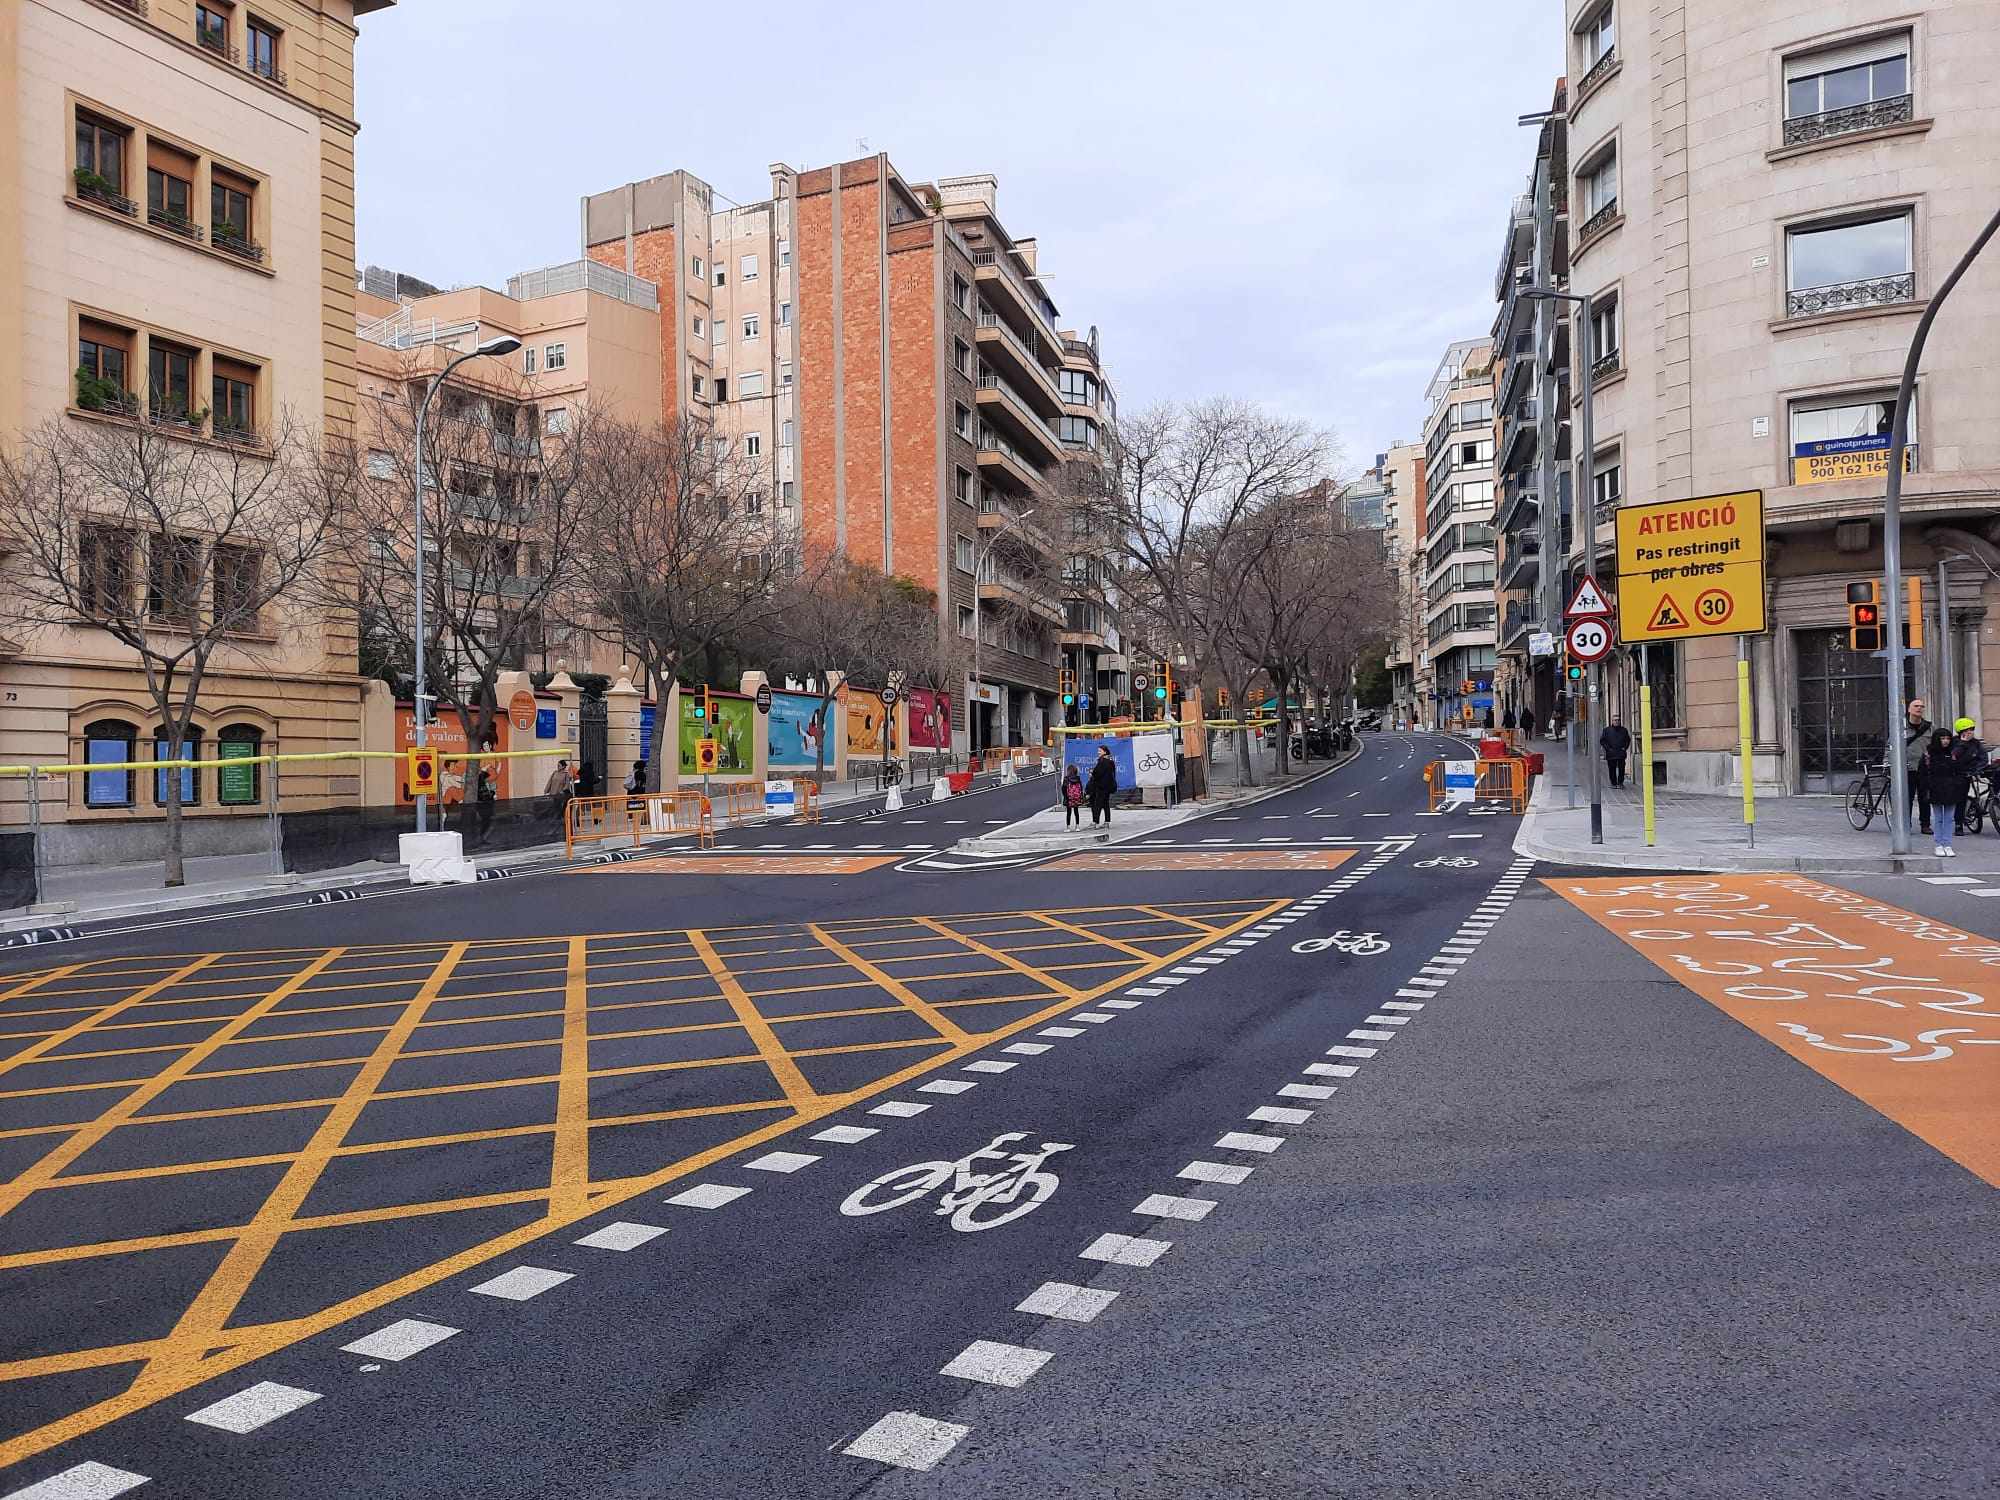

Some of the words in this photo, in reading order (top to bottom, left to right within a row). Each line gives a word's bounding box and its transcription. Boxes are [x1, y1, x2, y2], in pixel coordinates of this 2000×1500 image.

[1810, 450, 1891, 468] DISPONIBLE
[1811, 467, 1835, 478] 900
[1839, 465, 1861, 475] 162
[1867, 462, 1889, 472] 164
[1638, 501, 1736, 536] ATENCIÓ
[1636, 548, 1663, 561] Pas
[1668, 537, 1741, 558] restringit
[1651, 567, 1675, 583] per
[1680, 562, 1725, 578] obres
[1703, 598, 1726, 616] 30
[1576, 632, 1602, 648] 30
[6, 692, 18, 701] 73
[1080, 695, 1087, 704] P
